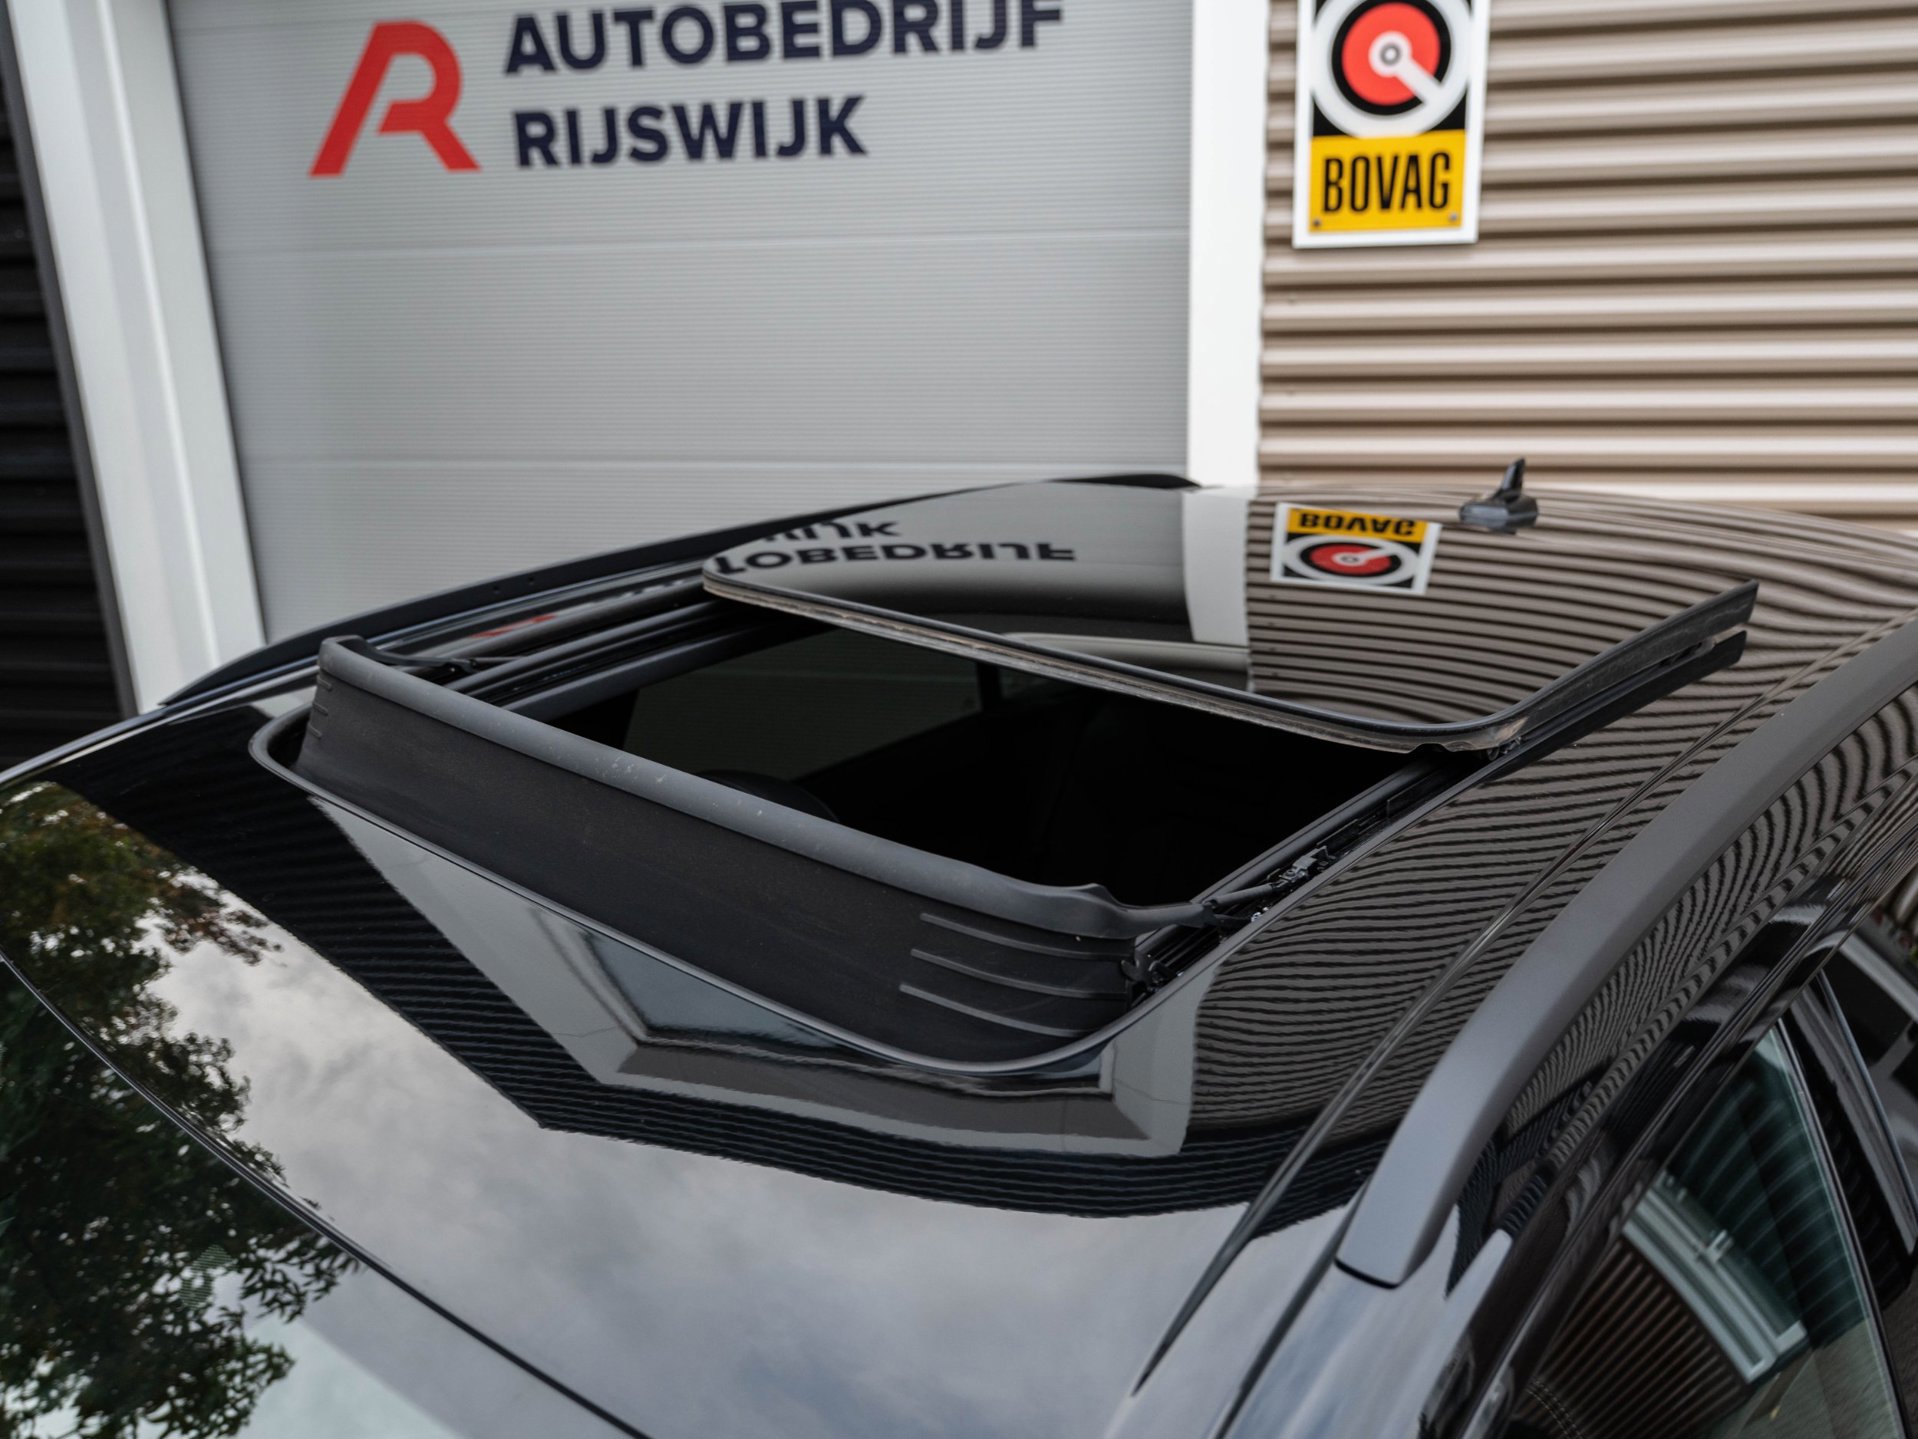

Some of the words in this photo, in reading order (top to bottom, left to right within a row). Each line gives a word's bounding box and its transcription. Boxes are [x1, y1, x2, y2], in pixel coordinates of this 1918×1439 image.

[504, 0, 1063, 75] AUTOBEDRIJF
[512, 96, 868, 168] RIJSWIJK
[1324, 152, 1451, 213] BOVAG
